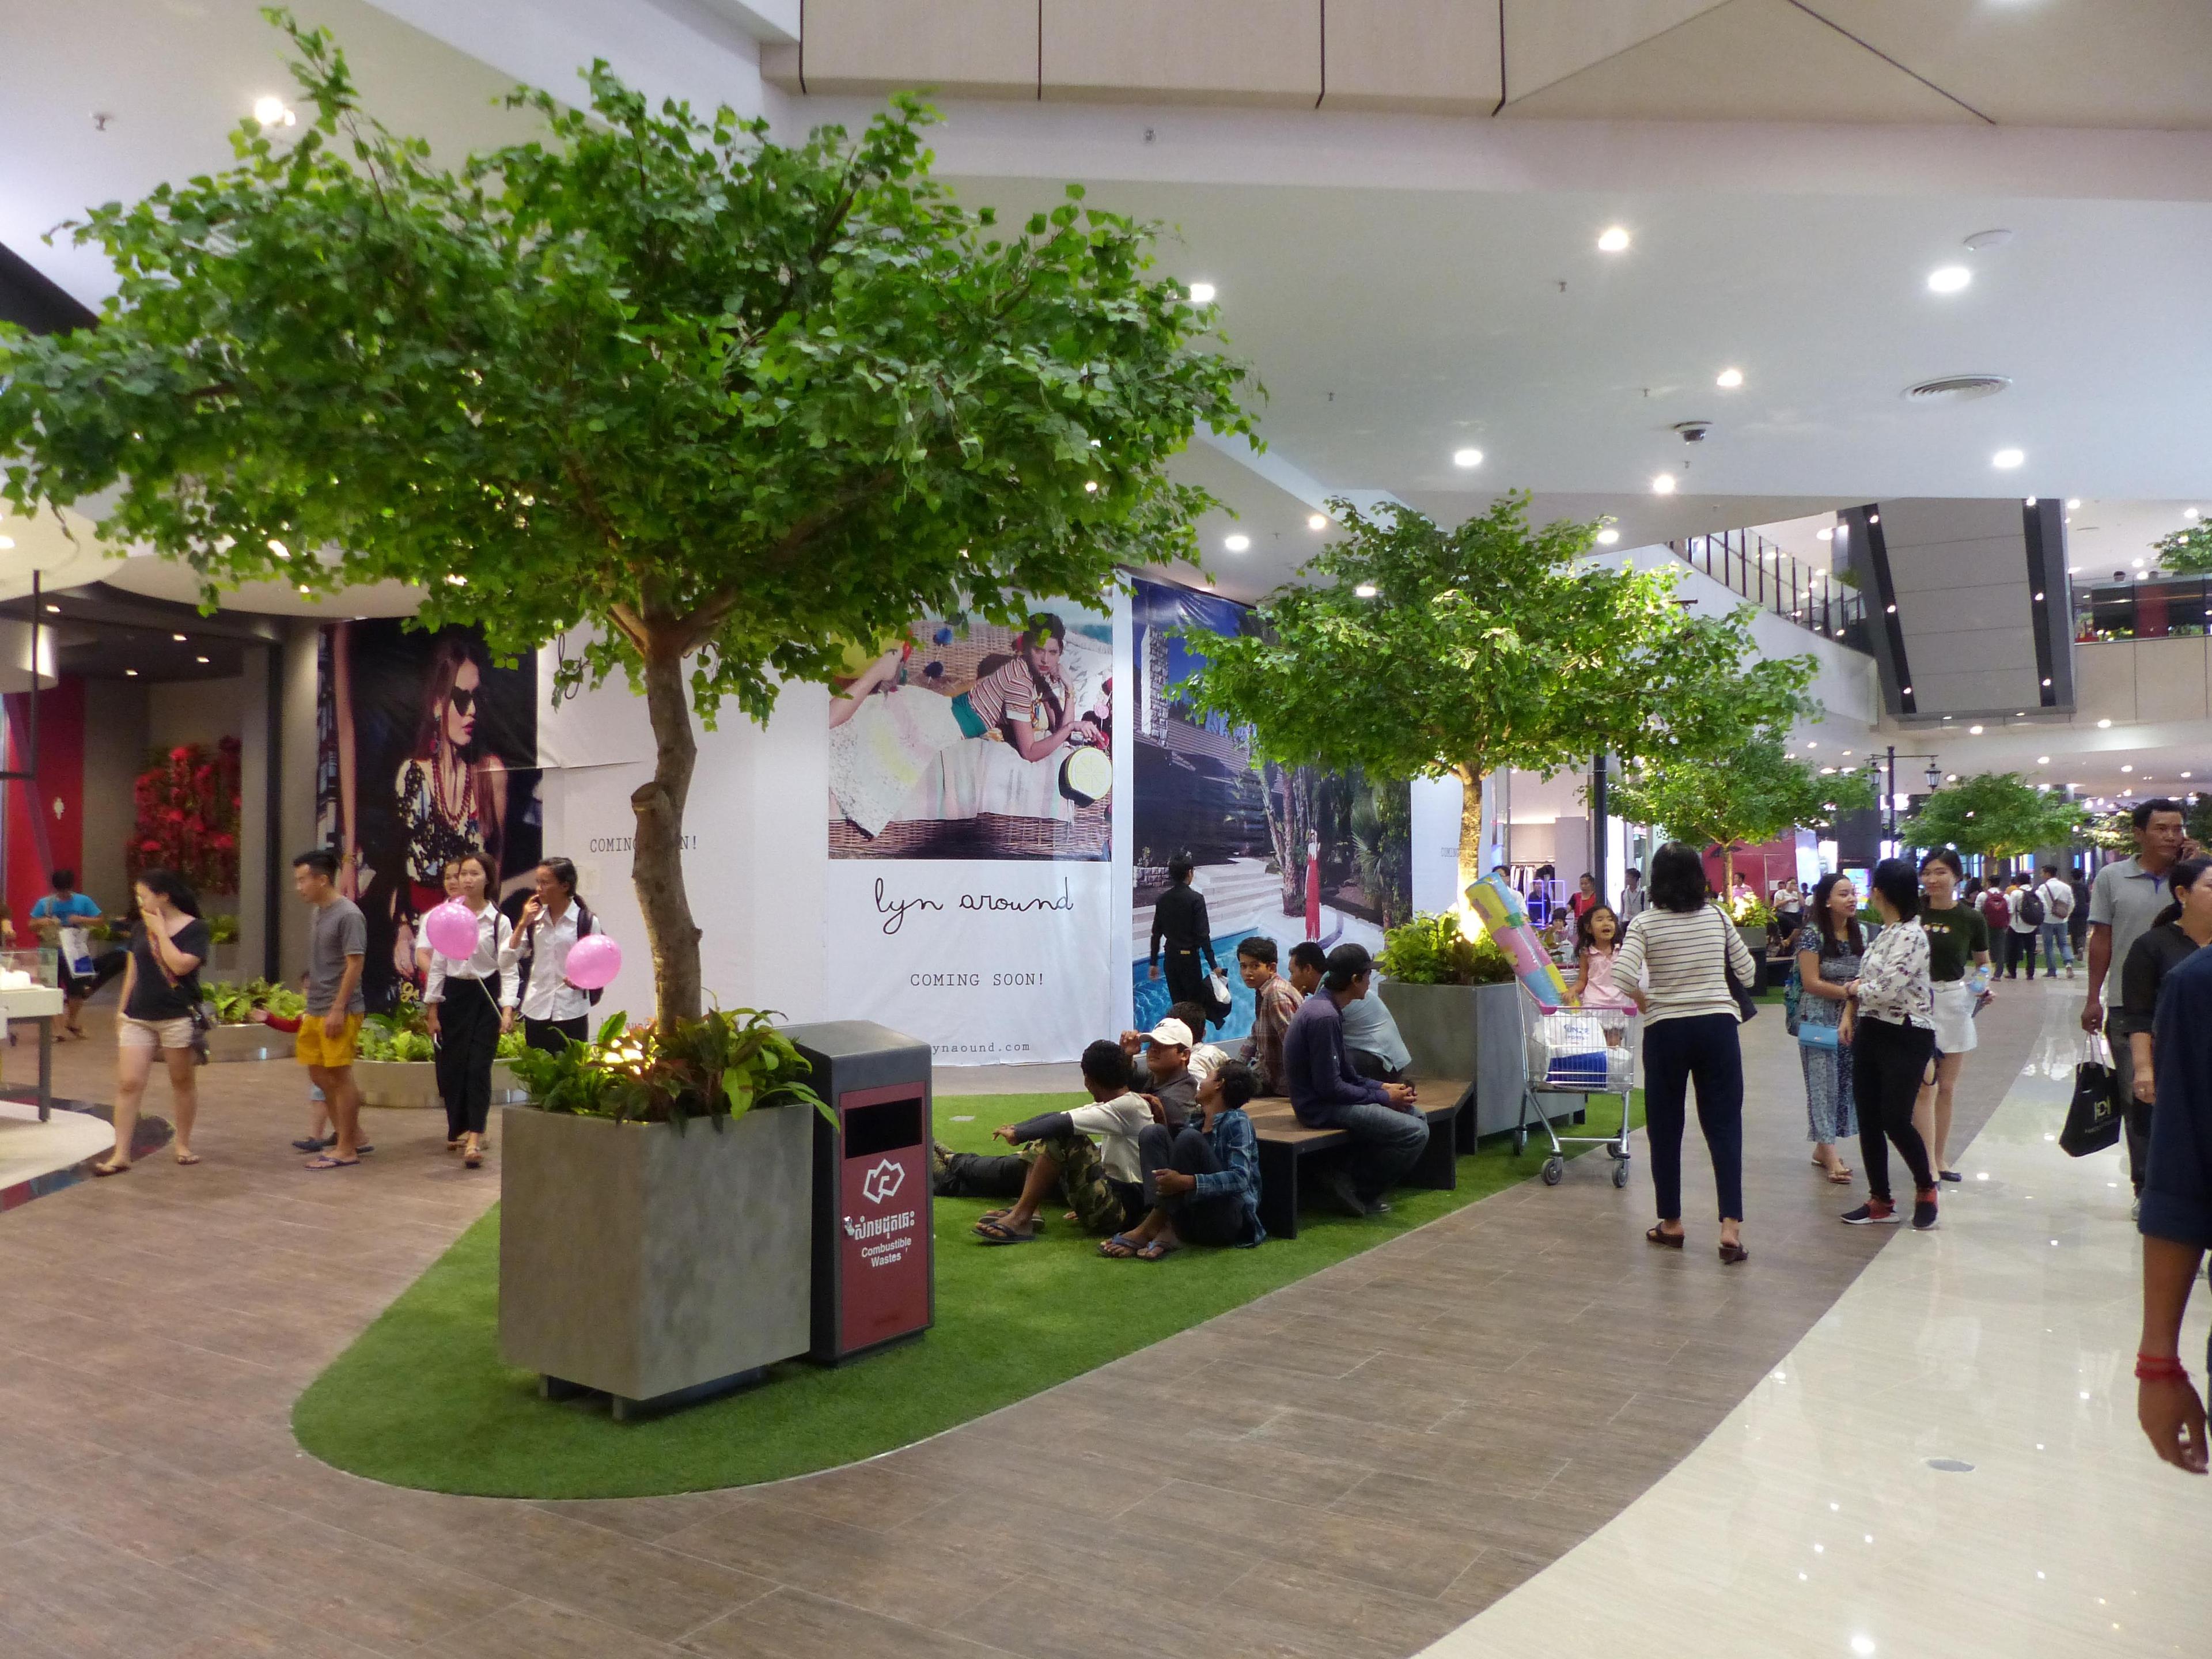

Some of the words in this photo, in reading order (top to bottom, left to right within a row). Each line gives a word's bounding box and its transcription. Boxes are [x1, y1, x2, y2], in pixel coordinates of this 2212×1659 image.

[875, 877, 944, 934] lyn
[959, 876, 1073, 911] around
[911, 974, 980, 986] COMING
[993, 973, 1043, 986] SOON!
[933, 1042, 1029, 1054] ynaound.com
[861, 1237, 911, 1257] Combustible
[872, 1252, 902, 1267] Wastes
